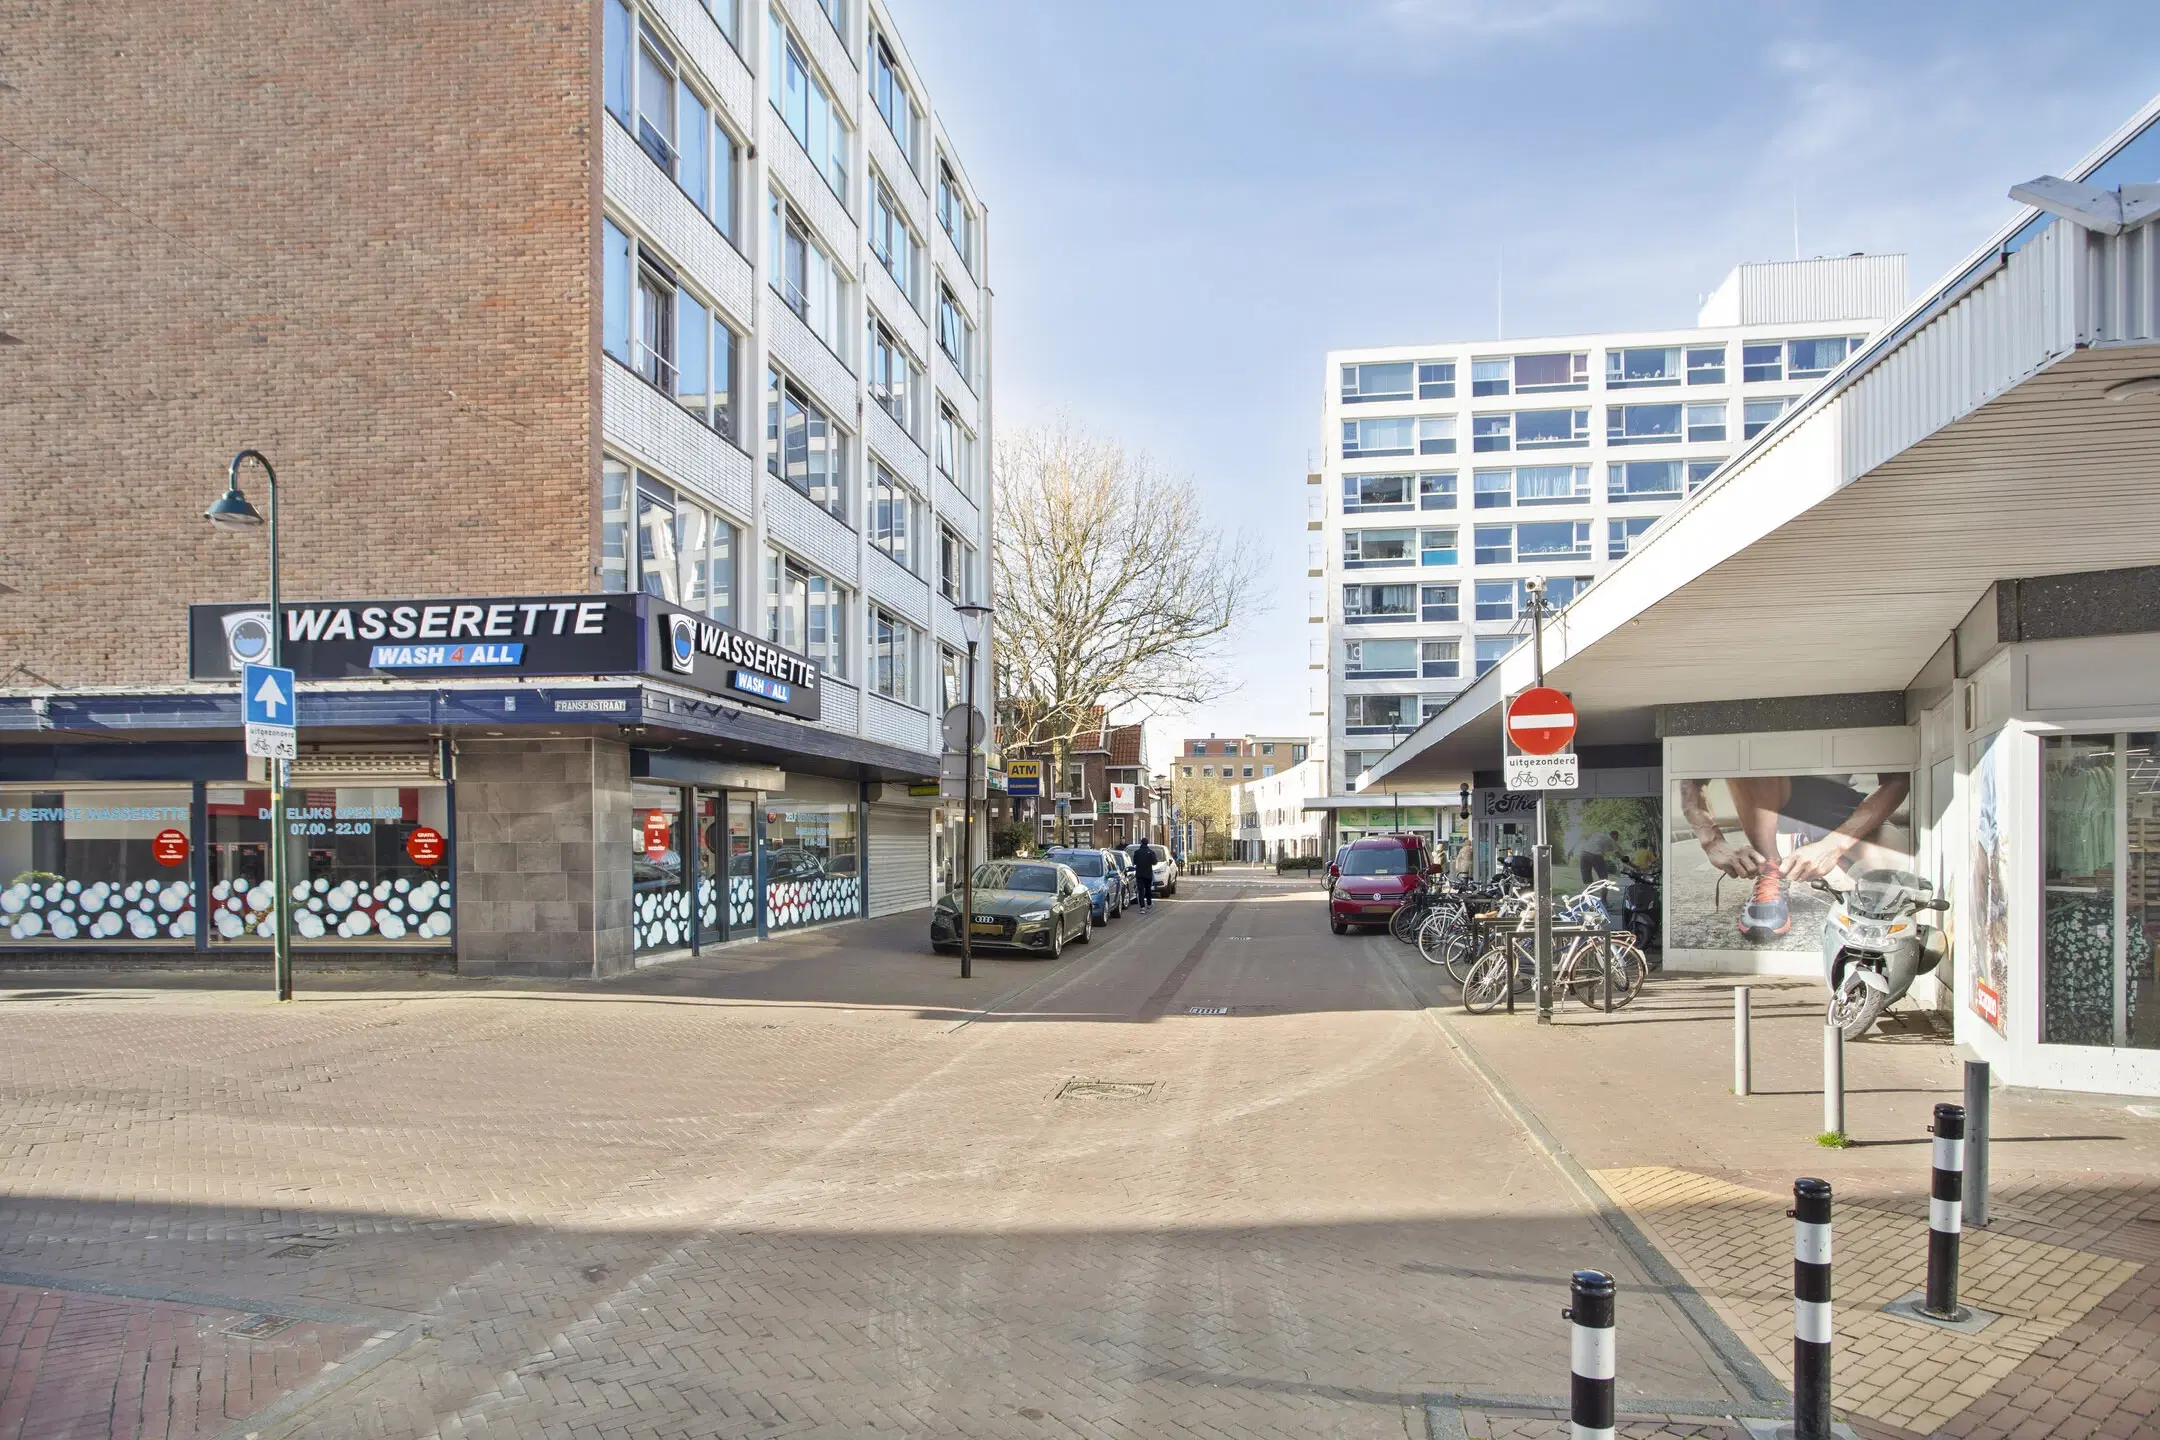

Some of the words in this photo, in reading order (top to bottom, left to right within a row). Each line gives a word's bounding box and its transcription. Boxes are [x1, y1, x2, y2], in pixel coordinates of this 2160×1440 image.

[287, 602, 607, 641] WASSERETTE
[378, 646, 444, 665] WASH
[450, 647, 464, 663] 4
[469, 645, 514, 663] ALL
[700, 622, 815, 689] WASSERETTE
[738, 672, 764, 694] WASH
[765, 683, 772, 695] 4
[772, 685, 788, 701] ALL
[1011, 765, 1037, 775] ATM
[1509, 757, 1576, 768] uitgezonderd
[19, 807, 83, 822] SERVICE
[87, 807, 189, 821] WASSERETTE
[258, 807, 332, 820] DELIJKS
[335, 807, 372, 820] OPEN
[374, 806, 403, 820] VAN
[290, 822, 326, 835] 07.00
[335, 822, 371, 835] 22.00
